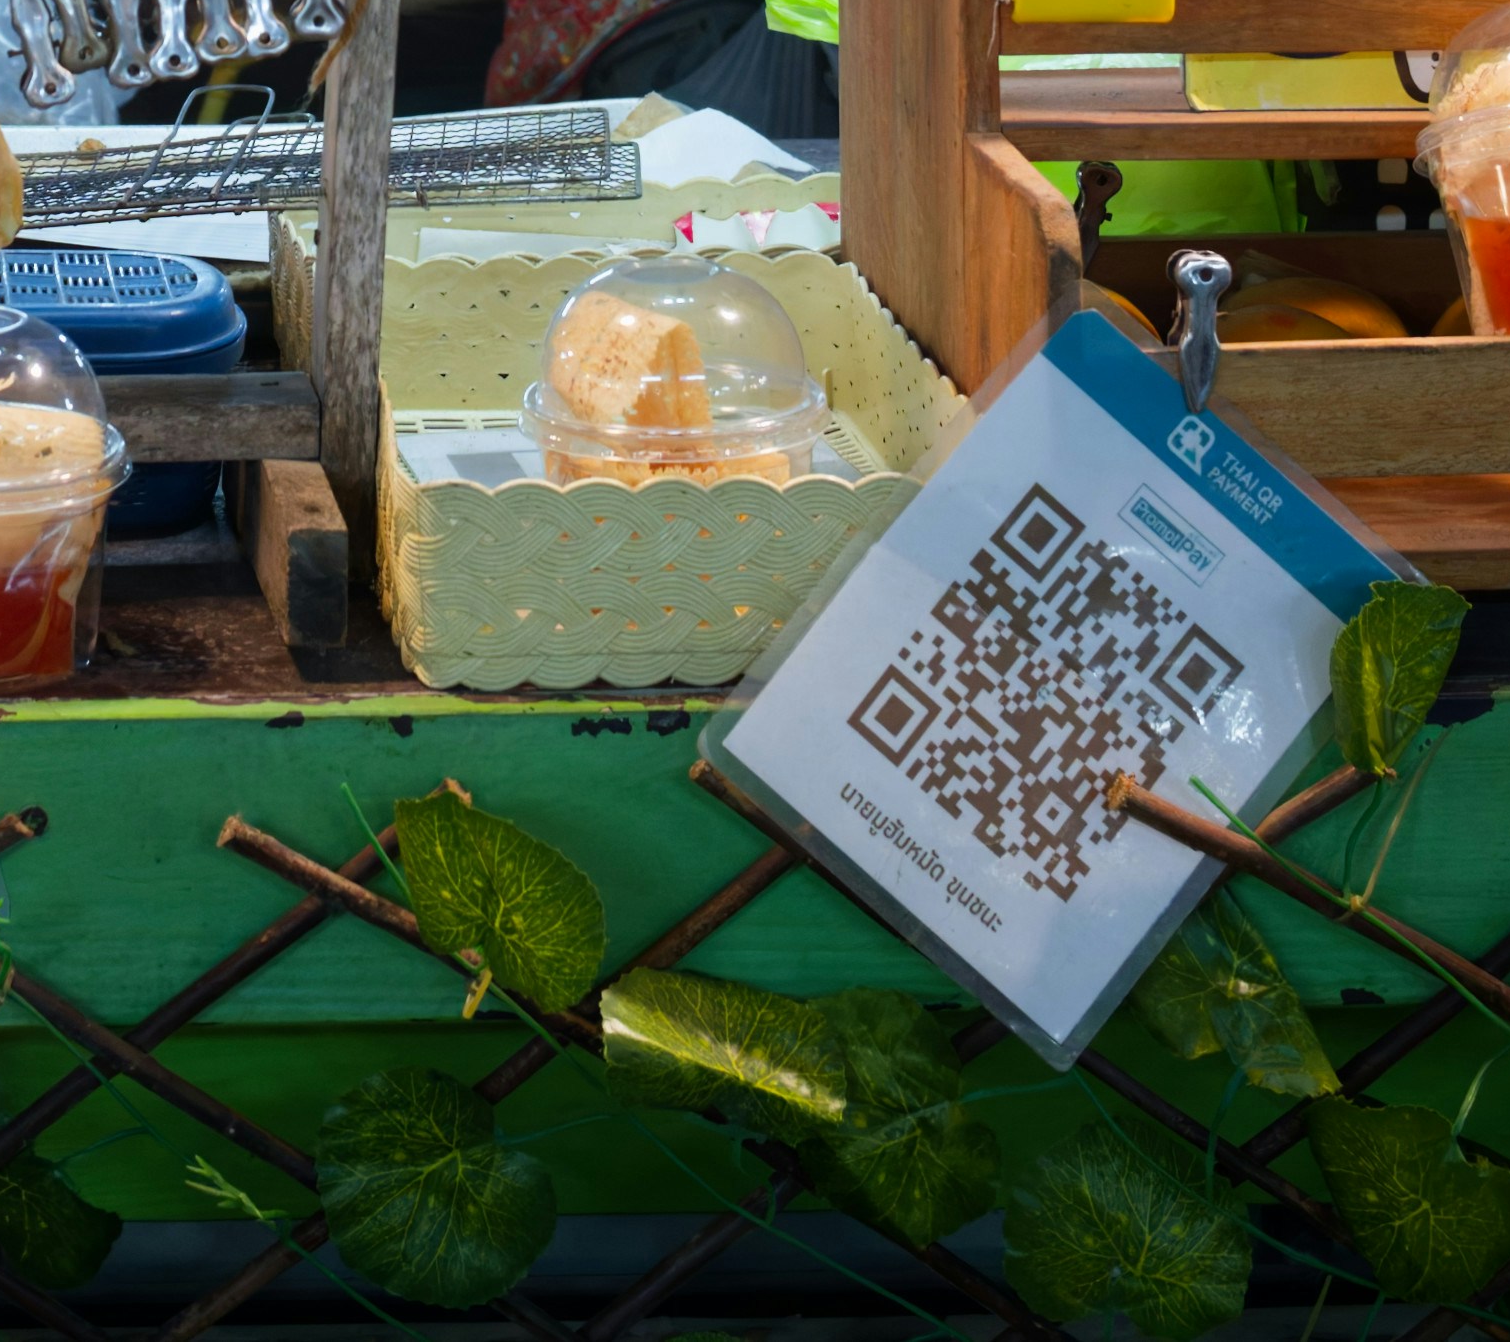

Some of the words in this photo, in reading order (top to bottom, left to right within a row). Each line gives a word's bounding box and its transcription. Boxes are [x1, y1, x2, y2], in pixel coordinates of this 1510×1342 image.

[1206, 465, 1273, 526] PAYMENT
[1221, 451, 1260, 492] THAI
[1257, 485, 1284, 514] QR
